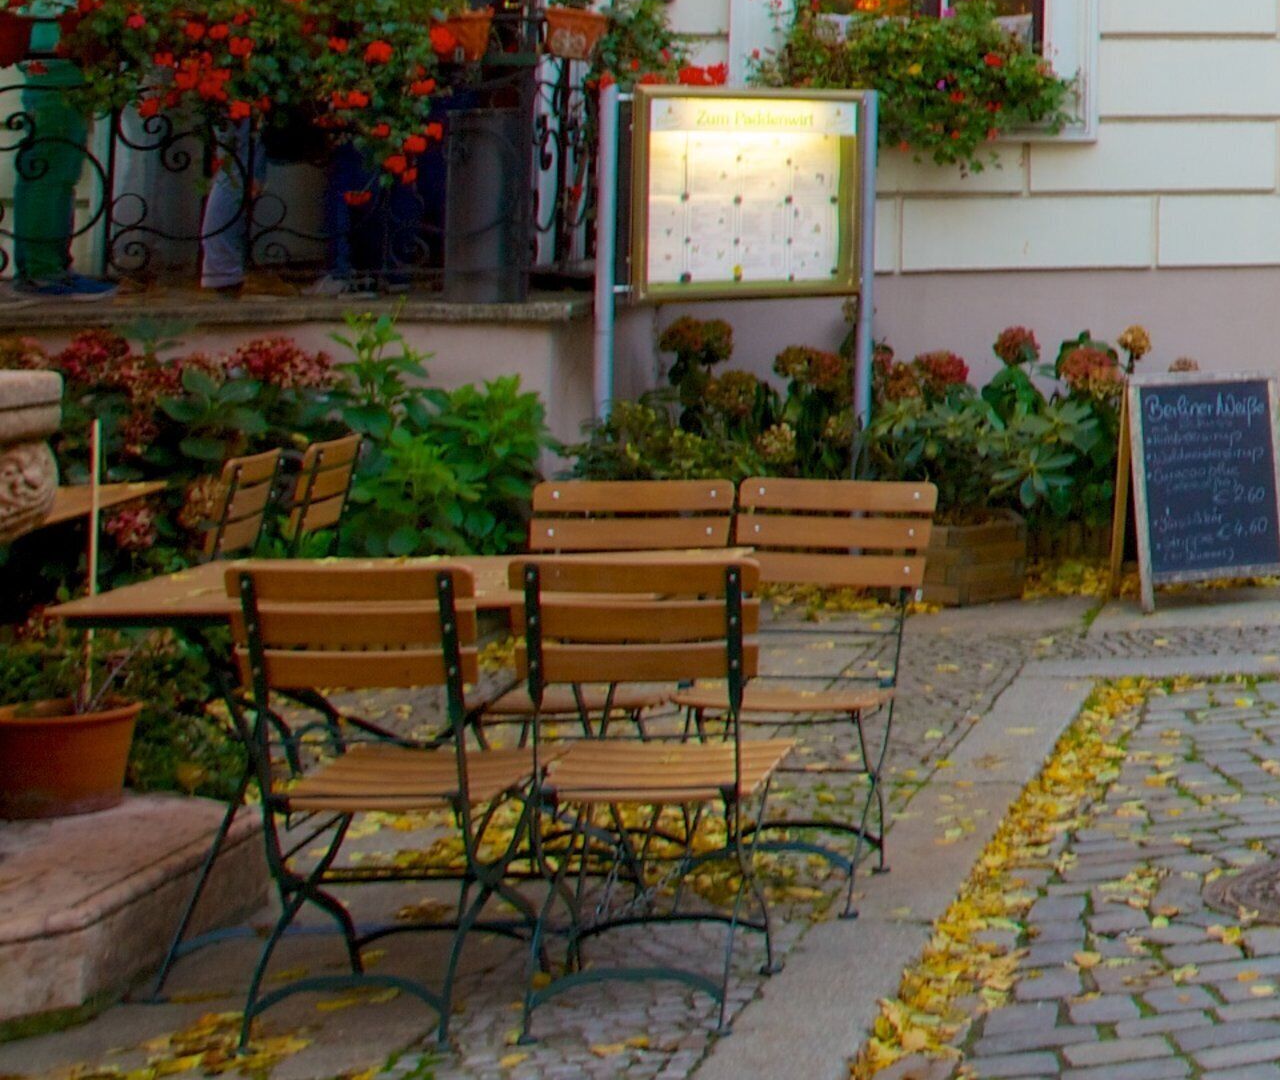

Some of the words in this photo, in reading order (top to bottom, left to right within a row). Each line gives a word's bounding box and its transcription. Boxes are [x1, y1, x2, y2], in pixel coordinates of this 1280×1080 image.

[696, 109, 729, 126] Zum
[734, 110, 814, 127] Paddenwirt
[1145, 394, 1214, 423] Berliner
